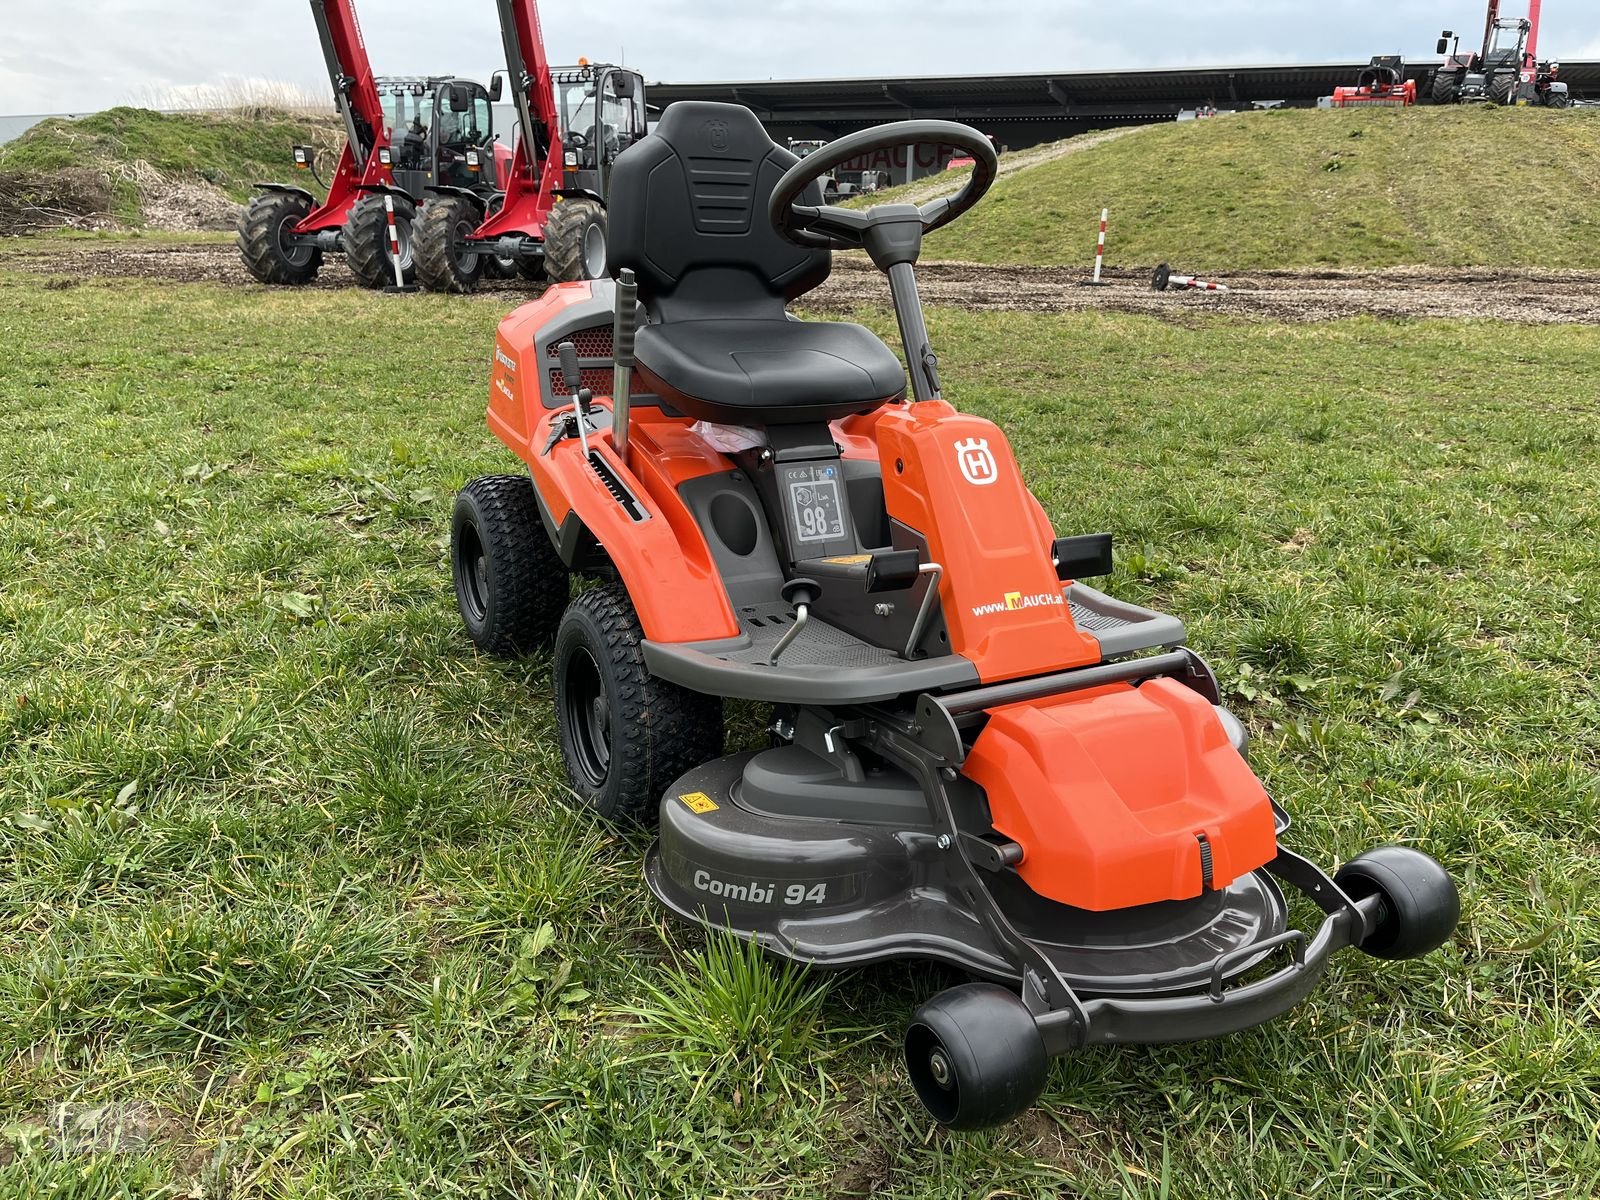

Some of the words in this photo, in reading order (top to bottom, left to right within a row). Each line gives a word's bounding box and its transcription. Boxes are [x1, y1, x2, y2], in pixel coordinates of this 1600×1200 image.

[803, 505, 828, 535] 98
[972, 591, 1064, 616] www.MAUCH.at
[693, 869, 775, 904] Combi
[784, 883, 827, 905] 94
